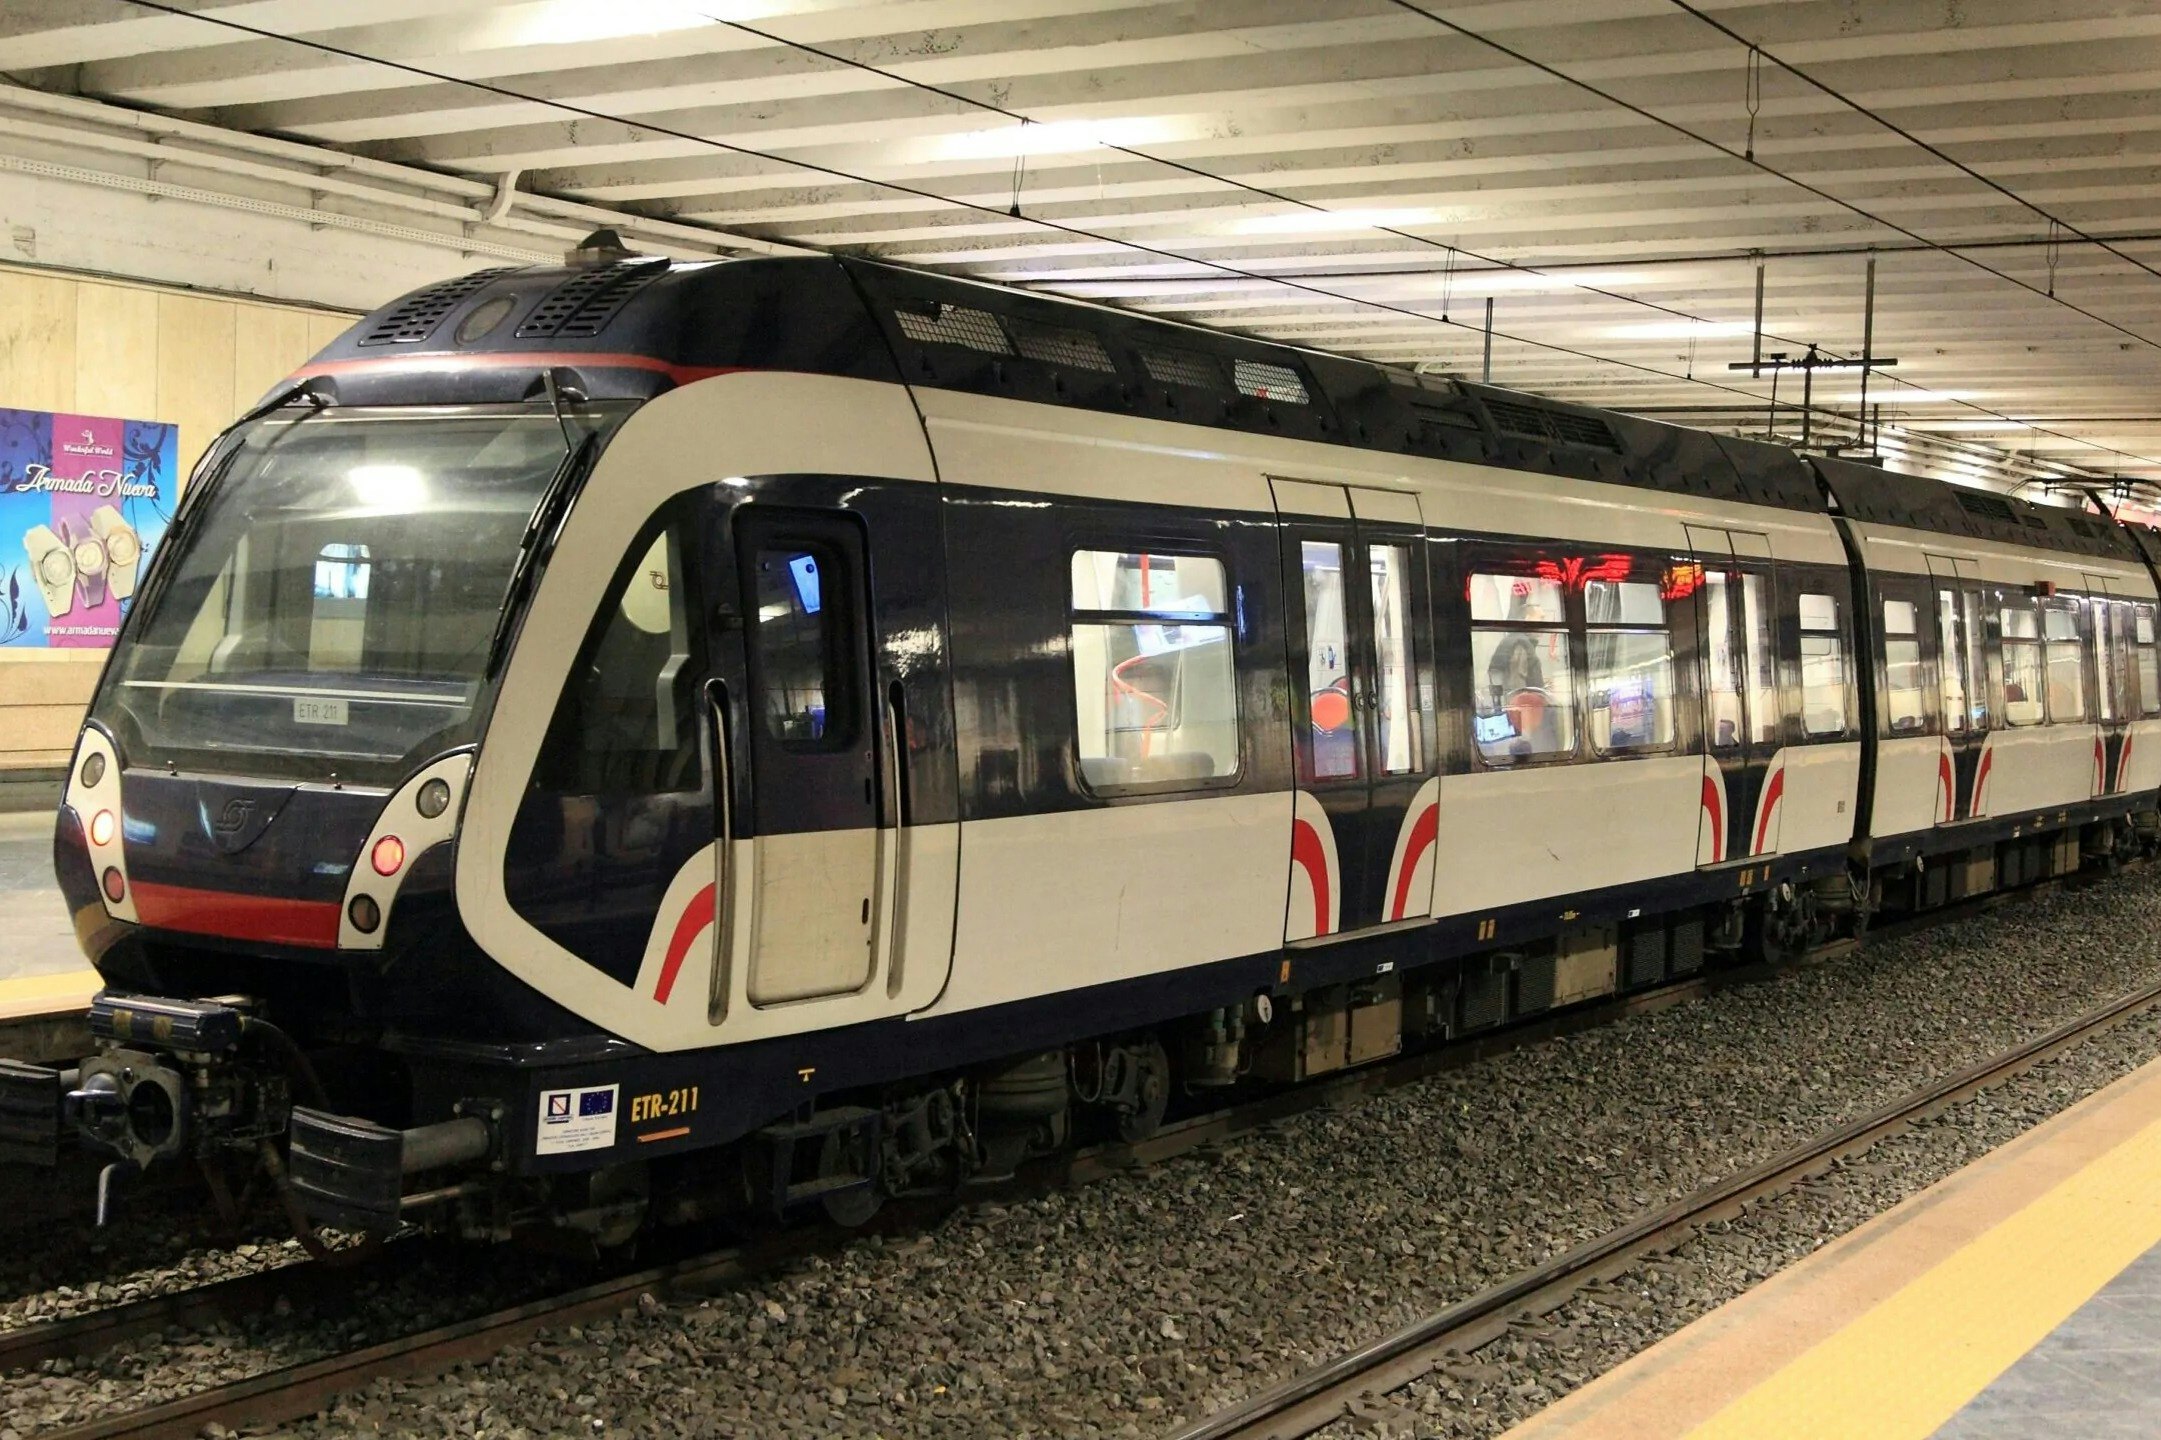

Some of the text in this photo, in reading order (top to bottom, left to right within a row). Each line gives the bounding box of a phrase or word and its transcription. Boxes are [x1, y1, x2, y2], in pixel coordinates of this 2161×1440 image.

[16, 463, 156, 497] Armada Nueva
[299, 704, 338, 719] ETR 211
[630, 1086, 698, 1122] ETR-211
